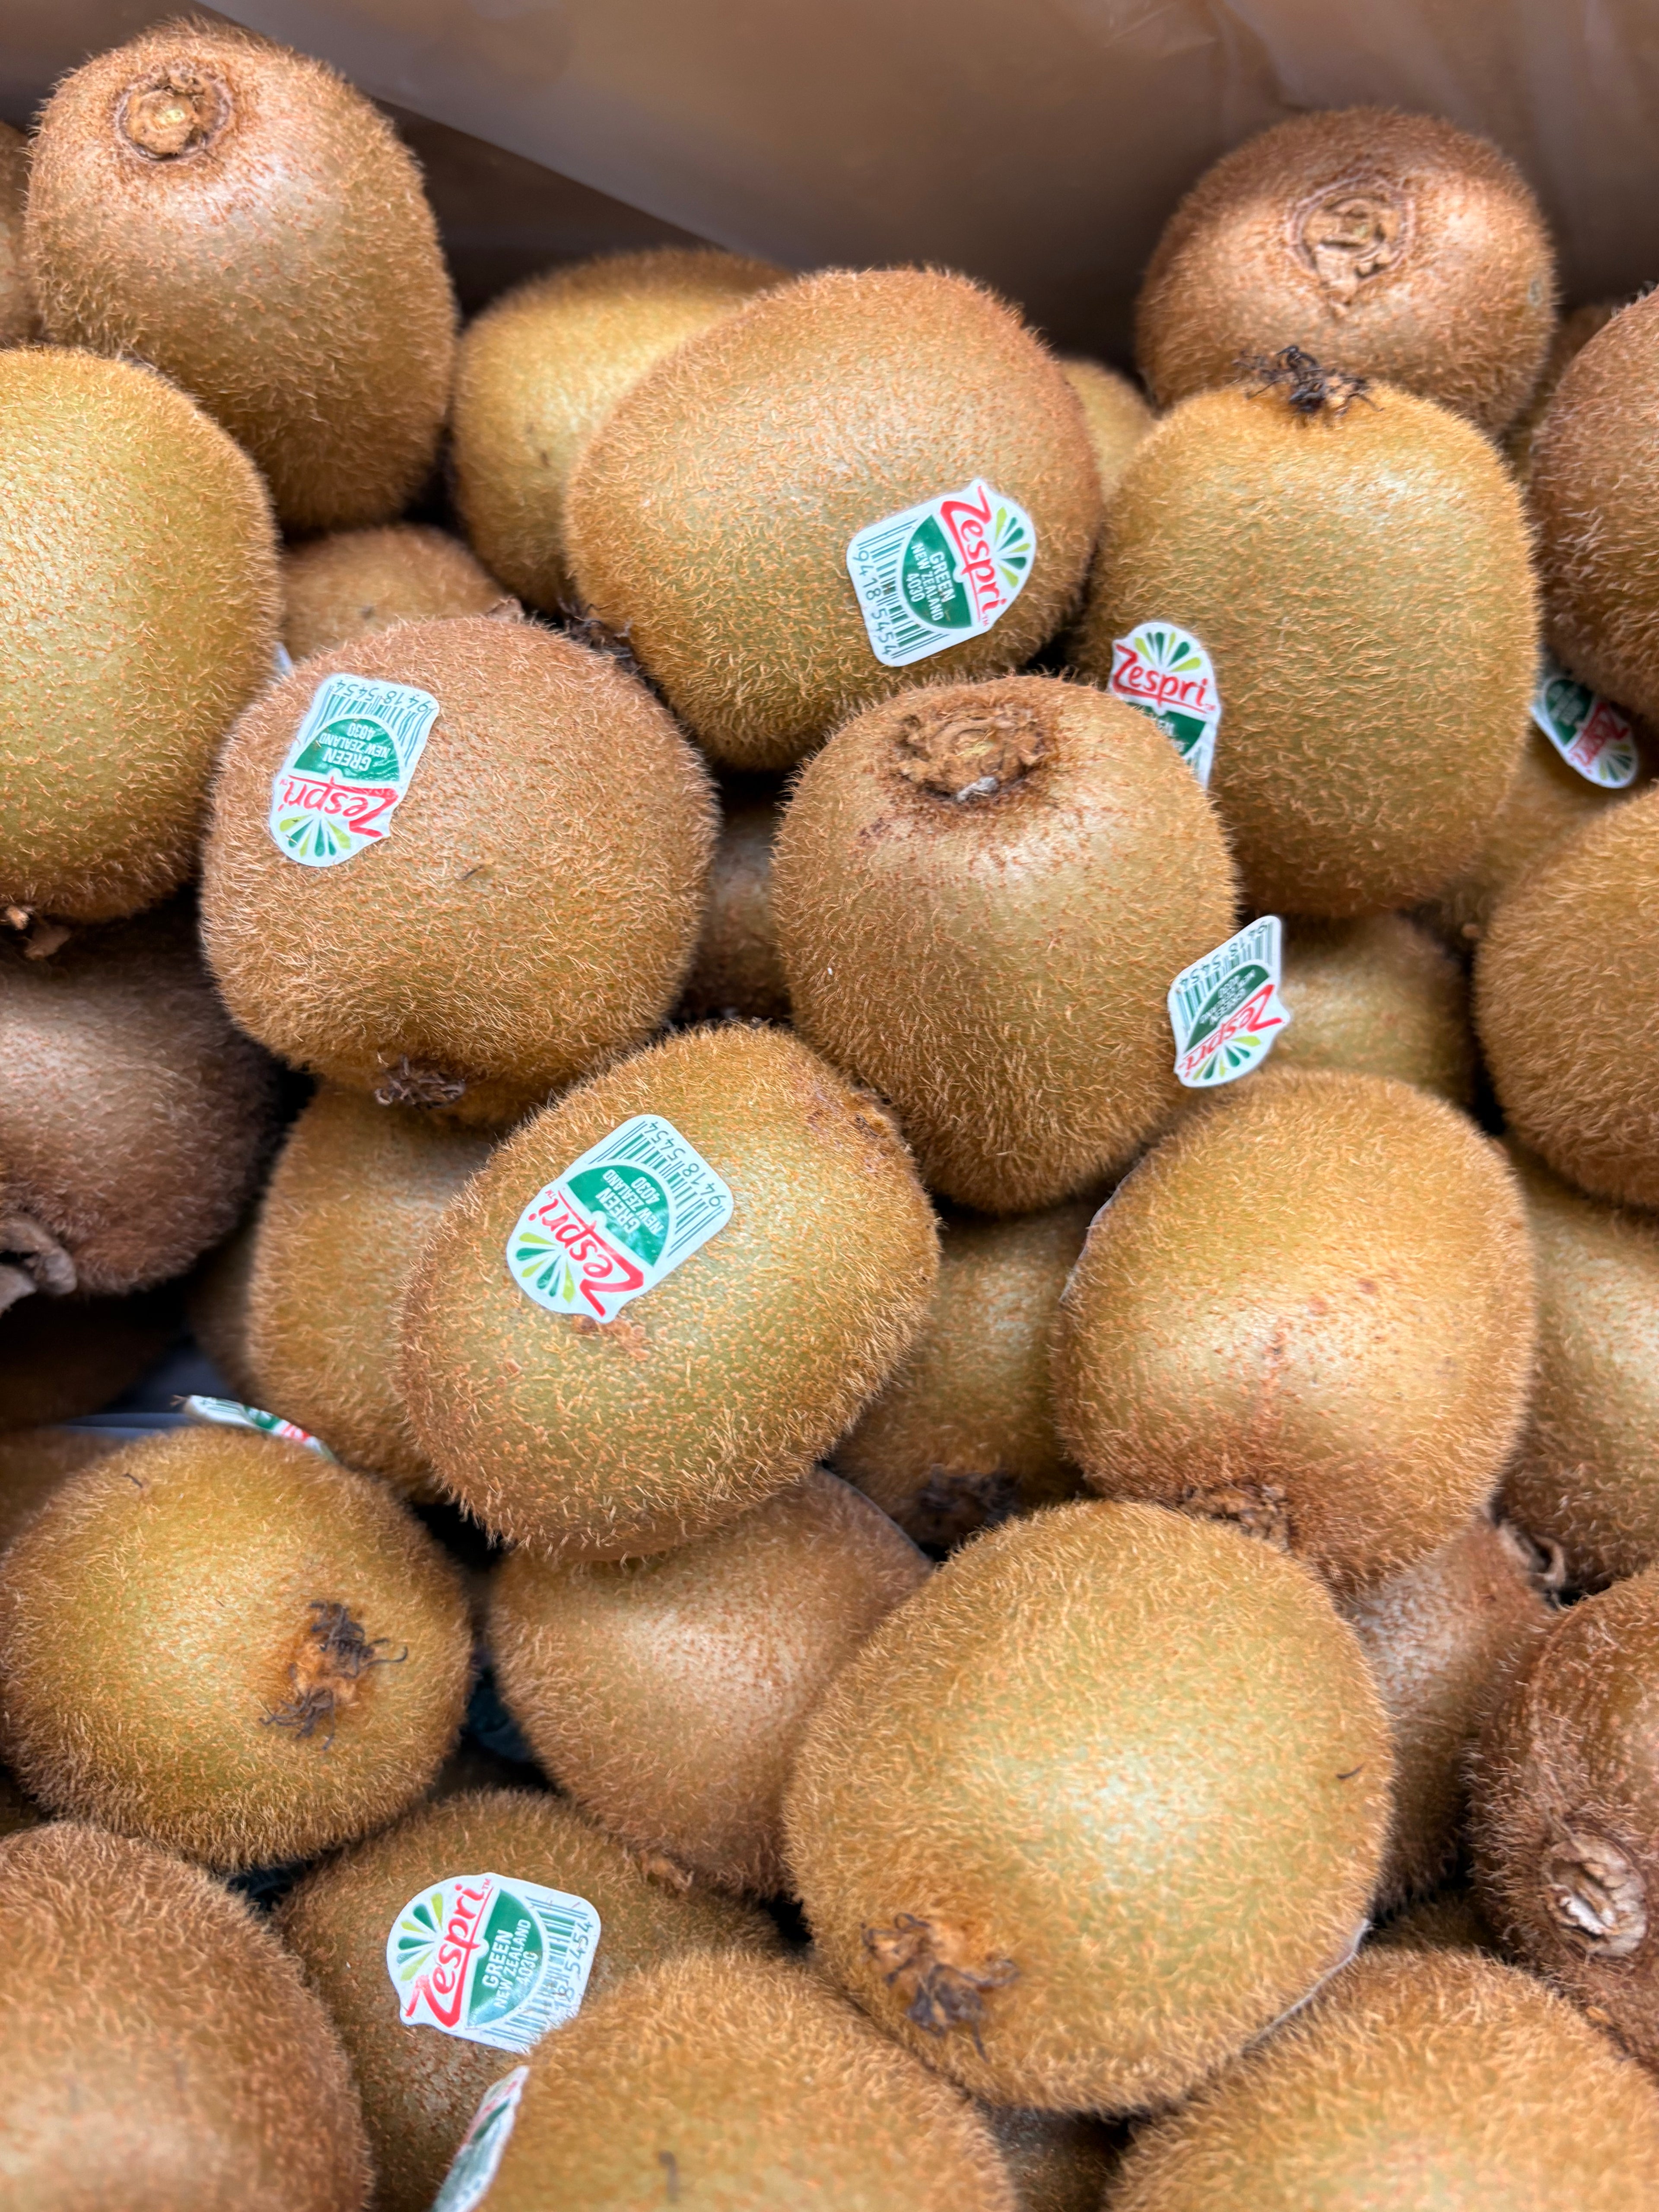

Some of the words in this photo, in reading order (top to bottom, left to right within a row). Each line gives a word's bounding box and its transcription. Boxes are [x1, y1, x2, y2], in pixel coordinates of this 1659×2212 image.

[911, 543, 930, 571] NEW
[929, 551, 956, 604] GREEN
[939, 485, 1007, 623] Zespri
[906, 573, 925, 603] 4030
[920, 569, 944, 622] ZEALAND
[1112, 644, 1208, 714] Zespri
[319, 733, 364, 756] ZEALAND
[347, 722, 375, 741] 4030
[362, 743, 391, 760] NEW
[321, 747, 372, 772] GREEN
[277, 775, 399, 838] Zespri
[1183, 984, 1282, 1078] Zespri
[595, 1187, 641, 1234] GREEN
[602, 1169, 645, 1211] ZEALAND
[631, 1176, 661, 1205] 4030
[636, 1208, 664, 1235] NEW
[528, 1190, 644, 1318] Zespri
[405, 1883, 493, 2028] Zespri
[482, 1929, 513, 1989] GREEN
[493, 1978, 514, 2009] NEW
[504, 1919, 532, 1979] ZEALAND
